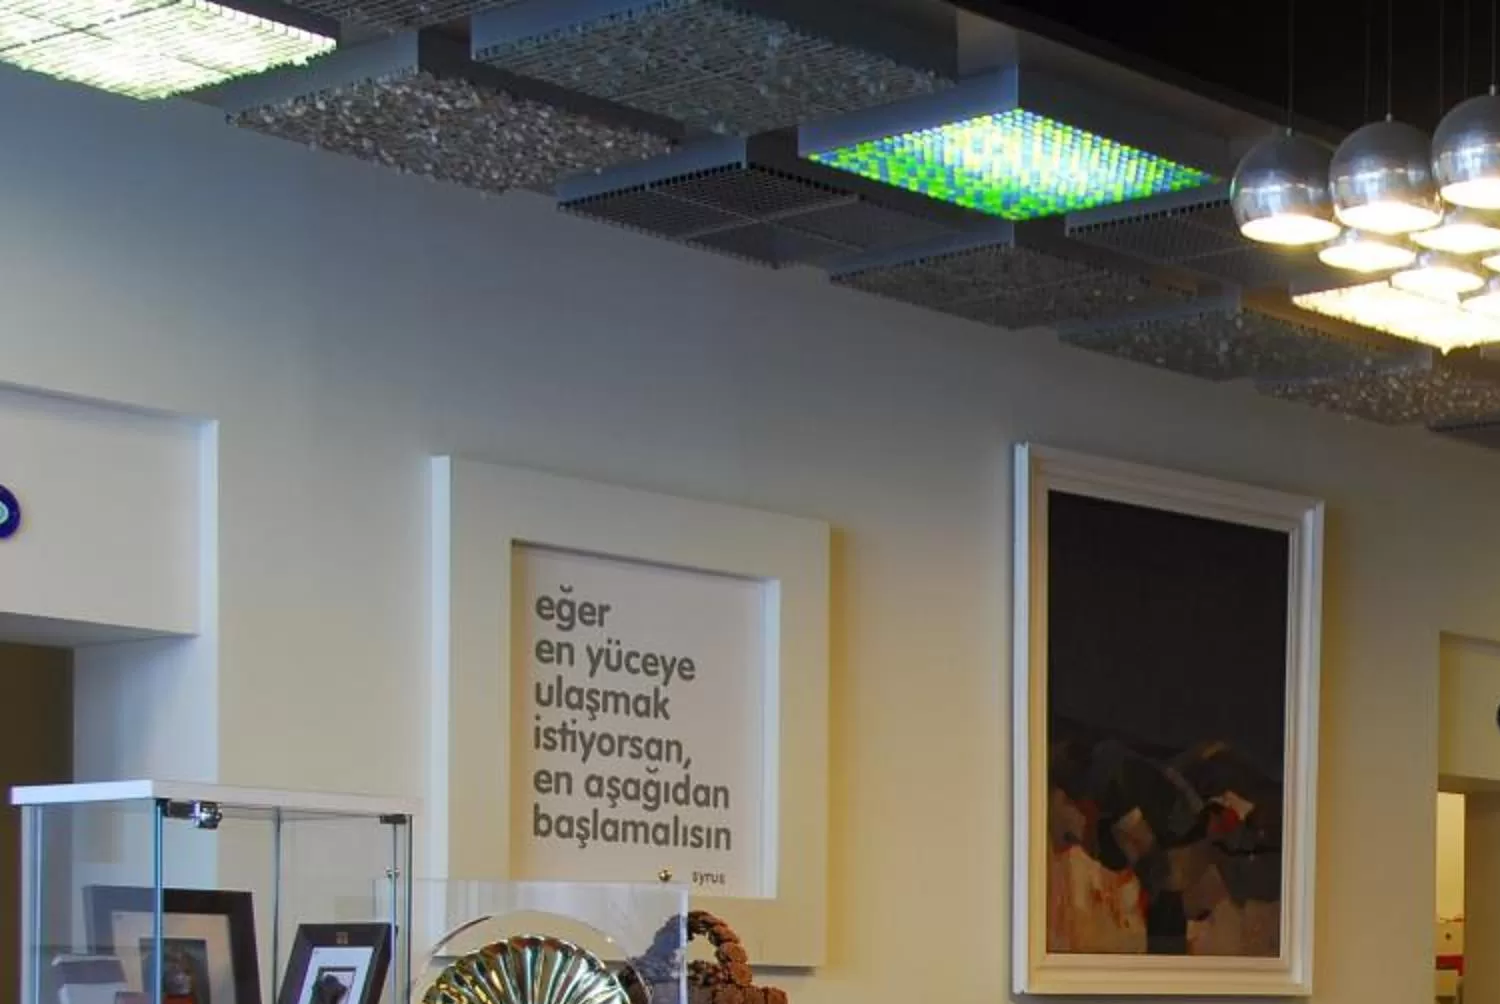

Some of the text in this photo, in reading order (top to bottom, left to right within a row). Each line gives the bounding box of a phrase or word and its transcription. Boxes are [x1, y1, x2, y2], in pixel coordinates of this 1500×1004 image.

[534, 584, 612, 632] eğer
[534, 638, 697, 686] en yüceye
[535, 674, 671, 721] ulaşmak
[534, 715, 693, 770] istiyorsan,
[533, 766, 731, 812] en aşağıdan
[532, 802, 732, 850] başlamalısın
